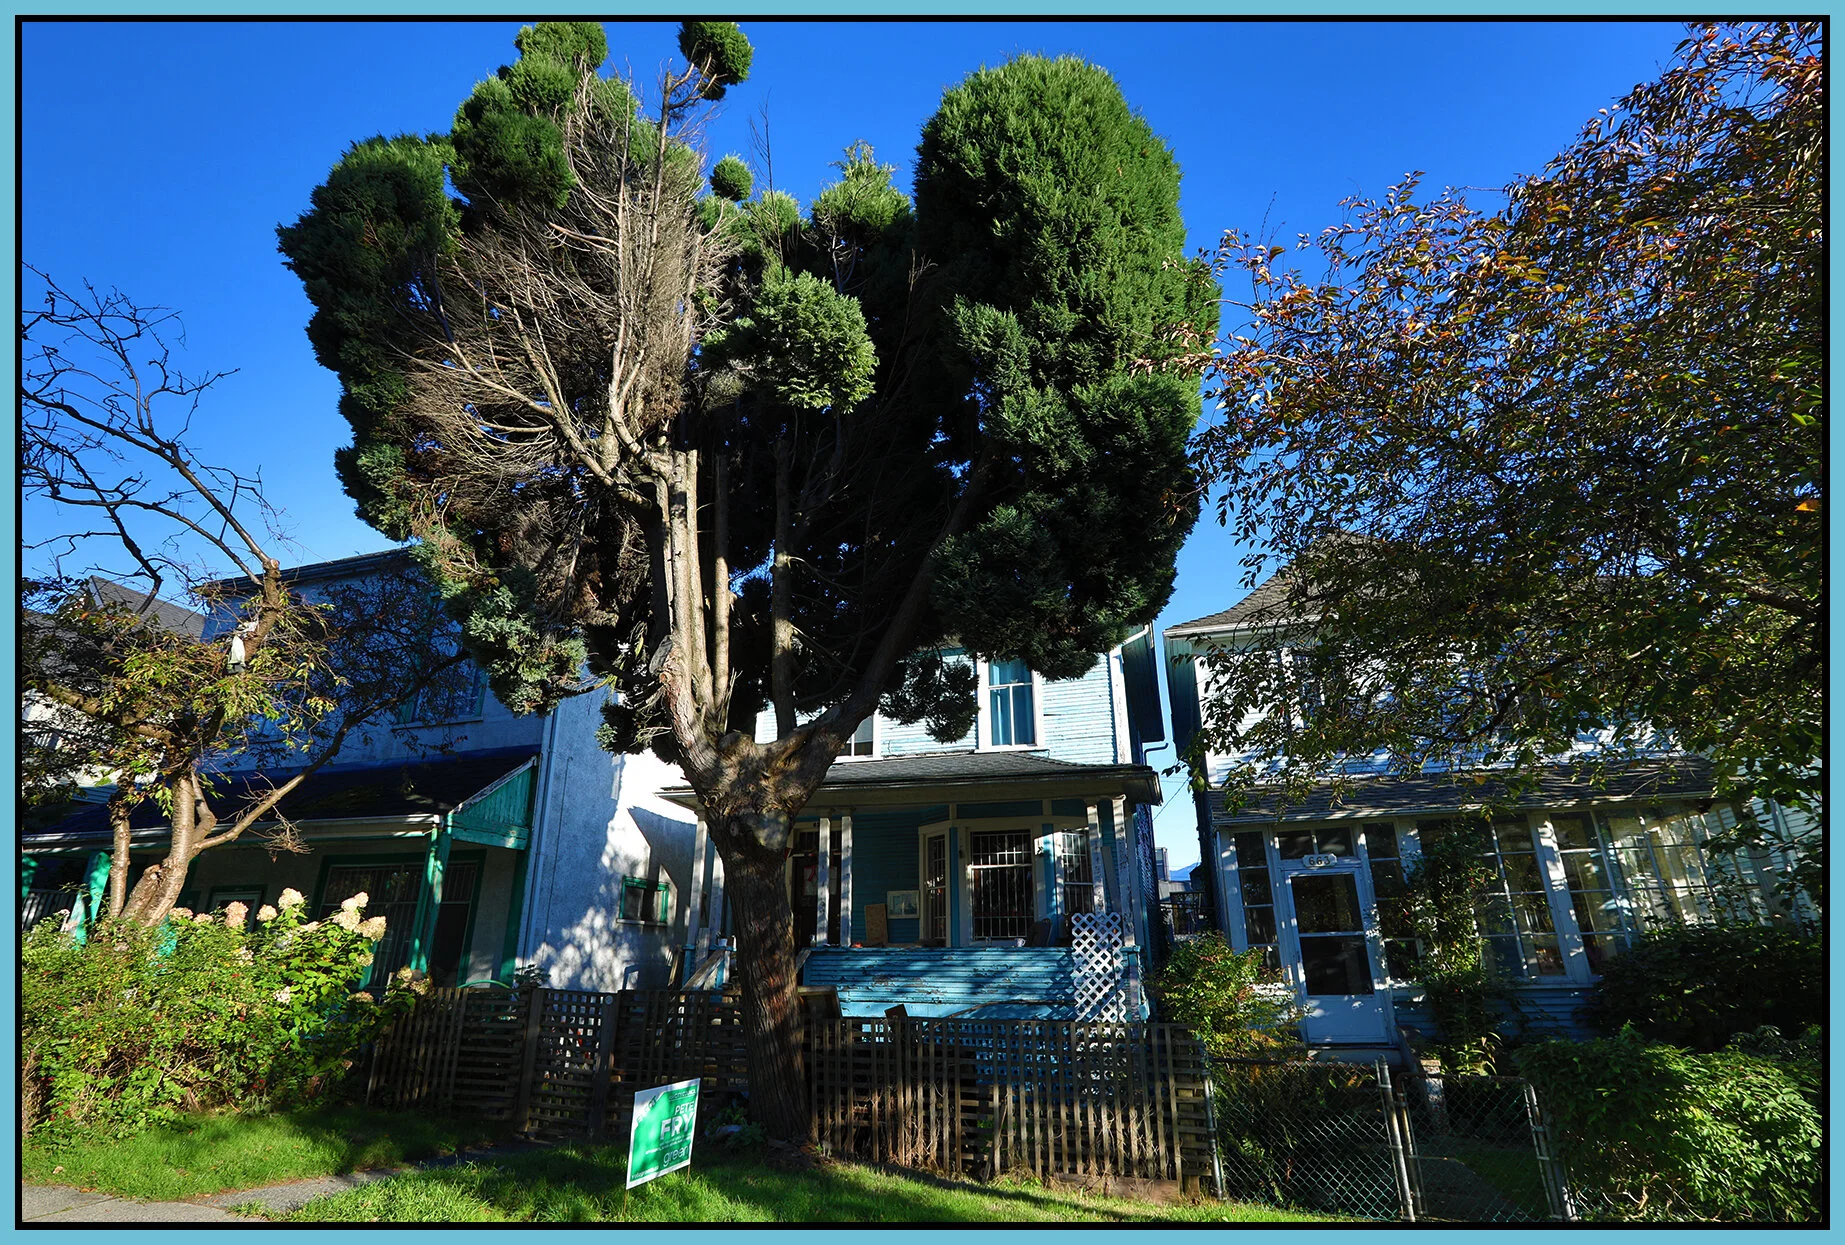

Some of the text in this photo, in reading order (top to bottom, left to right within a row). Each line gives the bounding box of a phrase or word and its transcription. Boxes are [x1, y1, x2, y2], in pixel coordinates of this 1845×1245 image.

[1309, 856, 1330, 865] 663
[674, 1101, 694, 1115] PETE
[660, 1112, 695, 1140] FRY
[664, 1146, 688, 1167] green
